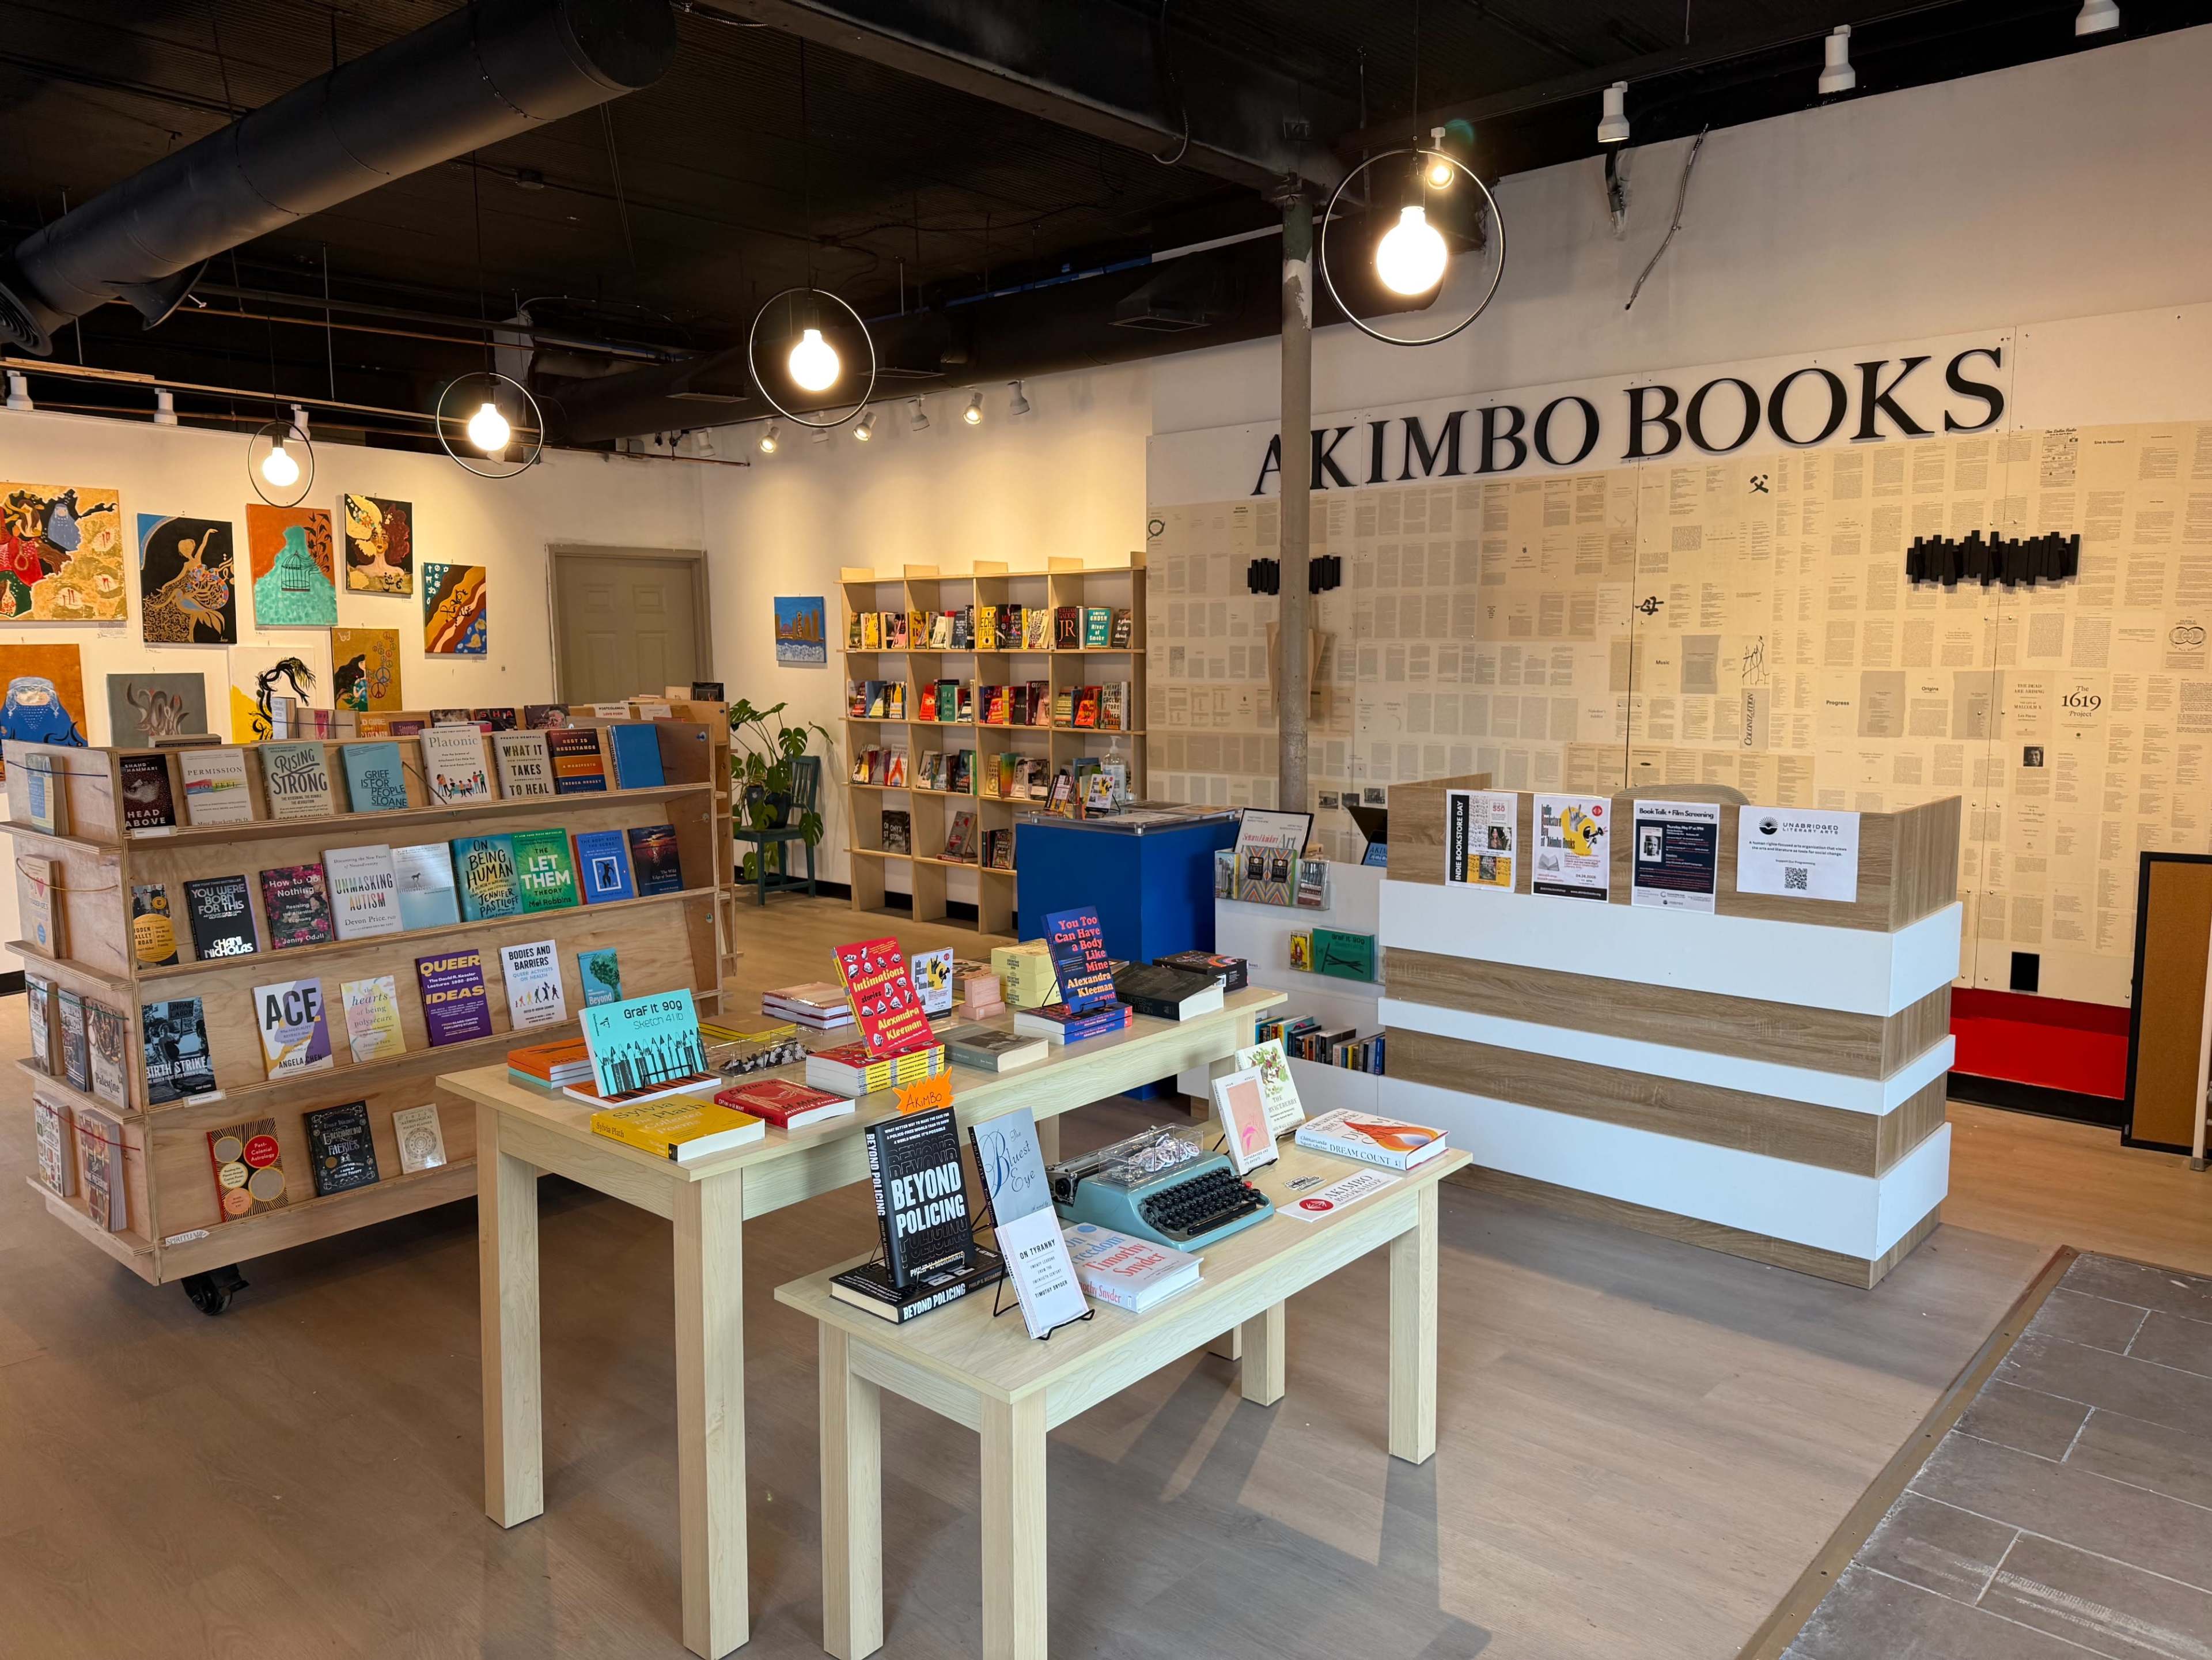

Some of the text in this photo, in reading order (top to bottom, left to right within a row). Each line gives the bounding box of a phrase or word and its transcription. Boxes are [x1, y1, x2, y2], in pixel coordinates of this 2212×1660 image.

[1249, 395, 1600, 496] AKIMBO
[1621, 347, 2006, 460] BOOKS
[1059, 619, 1076, 641] JR
[2061, 691, 2101, 711] 1619
[429, 735, 478, 748] Platonic
[503, 744, 542, 757] WHAT IT
[274, 748, 316, 773] RISING
[187, 766, 243, 776] PERMISSION
[365, 770, 389, 779] GRIEF
[511, 763, 542, 776] TAKES
[271, 772, 328, 795] STRONG
[370, 778, 389, 787] FOR
[371, 784, 406, 796] PEOPLE
[509, 783, 549, 796] TO HEAL
[372, 796, 407, 807] SLOANE
[1541, 804, 1552, 815] Indie
[127, 809, 160, 819] HEAD
[1541, 815, 1562, 827] Bookstore
[1685, 811, 1714, 819] Screening
[1541, 827, 1549, 839] Day
[1783, 822, 1839, 830] UNABRIDGED
[473, 840, 488, 852] ON
[468, 849, 506, 871] BEING
[528, 854, 558, 872] LET
[465, 857, 513, 890] HUMAN
[521, 870, 571, 890] THEM
[191, 883, 246, 898] YOU WERE
[277, 886, 315, 897] Nothing
[335, 873, 393, 894] UNMASKING
[205, 893, 235, 906] BORN
[350, 892, 386, 911] AUTISM
[478, 888, 515, 906] JENNIFER
[529, 896, 571, 907] Mel Robbins
[198, 901, 244, 914] FOR THIS
[480, 896, 519, 917] PASTILOFF
[1058, 916, 1097, 930] You Too
[282, 936, 303, 945] Jenny
[1055, 928, 1101, 943] Can Have
[204, 943, 253, 959] NICHOLAS
[1079, 938, 1103, 950] Body
[509, 945, 551, 961] BODIES AND
[1085, 950, 1106, 961] Like
[420, 954, 481, 977] QUEER
[514, 956, 549, 970] BARRIERS
[1085, 961, 1108, 972] Mine
[853, 966, 905, 992] Intimations
[1067, 973, 1112, 989] Alexandra
[425, 985, 484, 1005] IDEAS
[861, 990, 882, 1003] stories
[1077, 983, 1113, 997] Kleeman
[351, 992, 388, 1007] hearts
[589, 992, 612, 1005] Beyond
[662, 1000, 683, 1011] 90g
[266, 988, 317, 1030] ACE
[365, 1006, 387, 1015] being
[634, 1016, 664, 1030] Sketch
[878, 1007, 920, 1031] Alexandra
[886, 1020, 922, 1041] Kleeman
[174, 1057, 207, 1074] STRIKE
[279, 1054, 323, 1069] ANGELA CHEN
[96, 1072, 120, 1094] Palestine
[612, 1101, 707, 1120] Sylvia Plath
[644, 1111, 704, 1130] Collected
[596, 1122, 624, 1139] Sylvia Plath
[929, 1126, 946, 1135] POSSIBLE
[251, 1147, 272, 1155] Colonial
[328, 1140, 360, 1156] FAERIES
[1330, 1144, 1391, 1164] DREAM COUNT
[251, 1154, 275, 1162] Astrology
[866, 1133, 885, 1217] BEYOND POLICING
[1010, 1167, 1035, 1192] Eye
[891, 1162, 961, 1211] BEYOND
[1325, 1175, 1374, 1199] AKIMBO
[1334, 1179, 1381, 1203] BOOKSHOP
[896, 1194, 965, 1238] POLICING
[1020, 1239, 1055, 1260] ON TYRANNY
[1082, 1243, 1153, 1272] Timothy
[1113, 1252, 1166, 1277] Snyder
[1035, 1280, 1068, 1298] TIMOTHY SNYDER
[1099, 1285, 1122, 1303] Snyder
[903, 1283, 965, 1320] BEYOND POLICING
